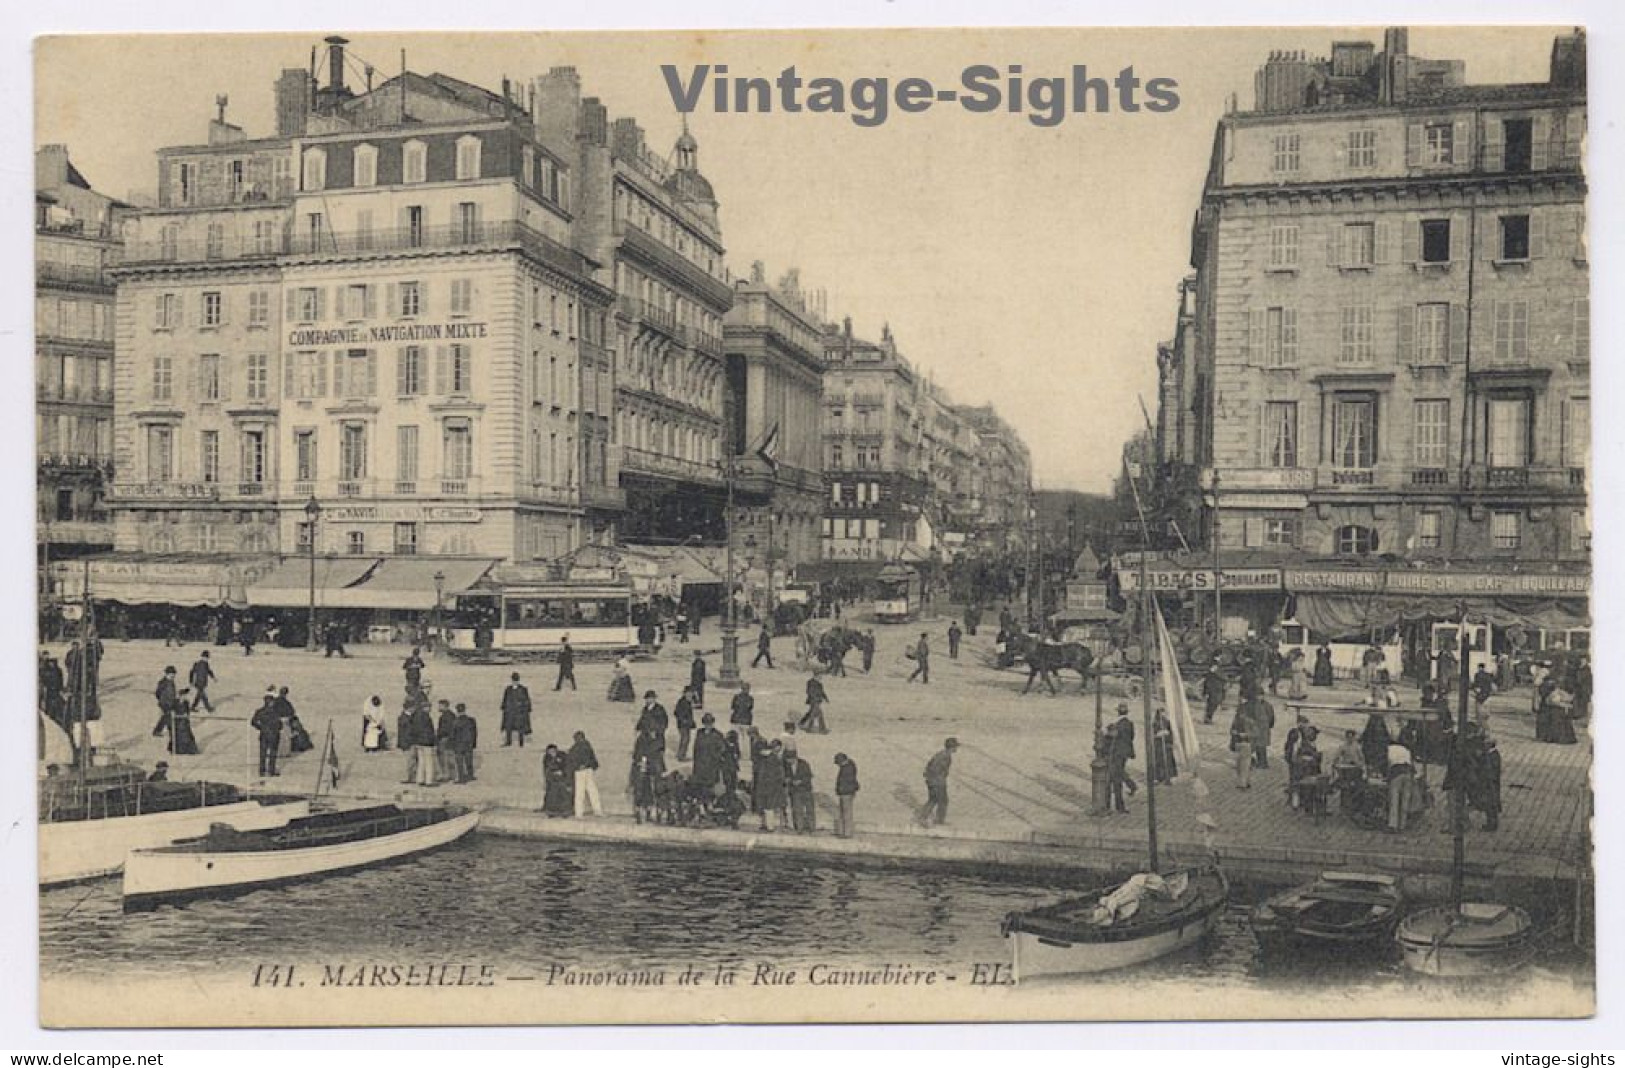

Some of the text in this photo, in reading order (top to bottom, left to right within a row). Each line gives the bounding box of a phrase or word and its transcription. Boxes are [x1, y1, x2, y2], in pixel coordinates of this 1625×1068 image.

[289, 329, 358, 346] COMPAGNIE
[370, 325, 441, 341] NAVIGATION
[445, 323, 488, 339] MIXTE
